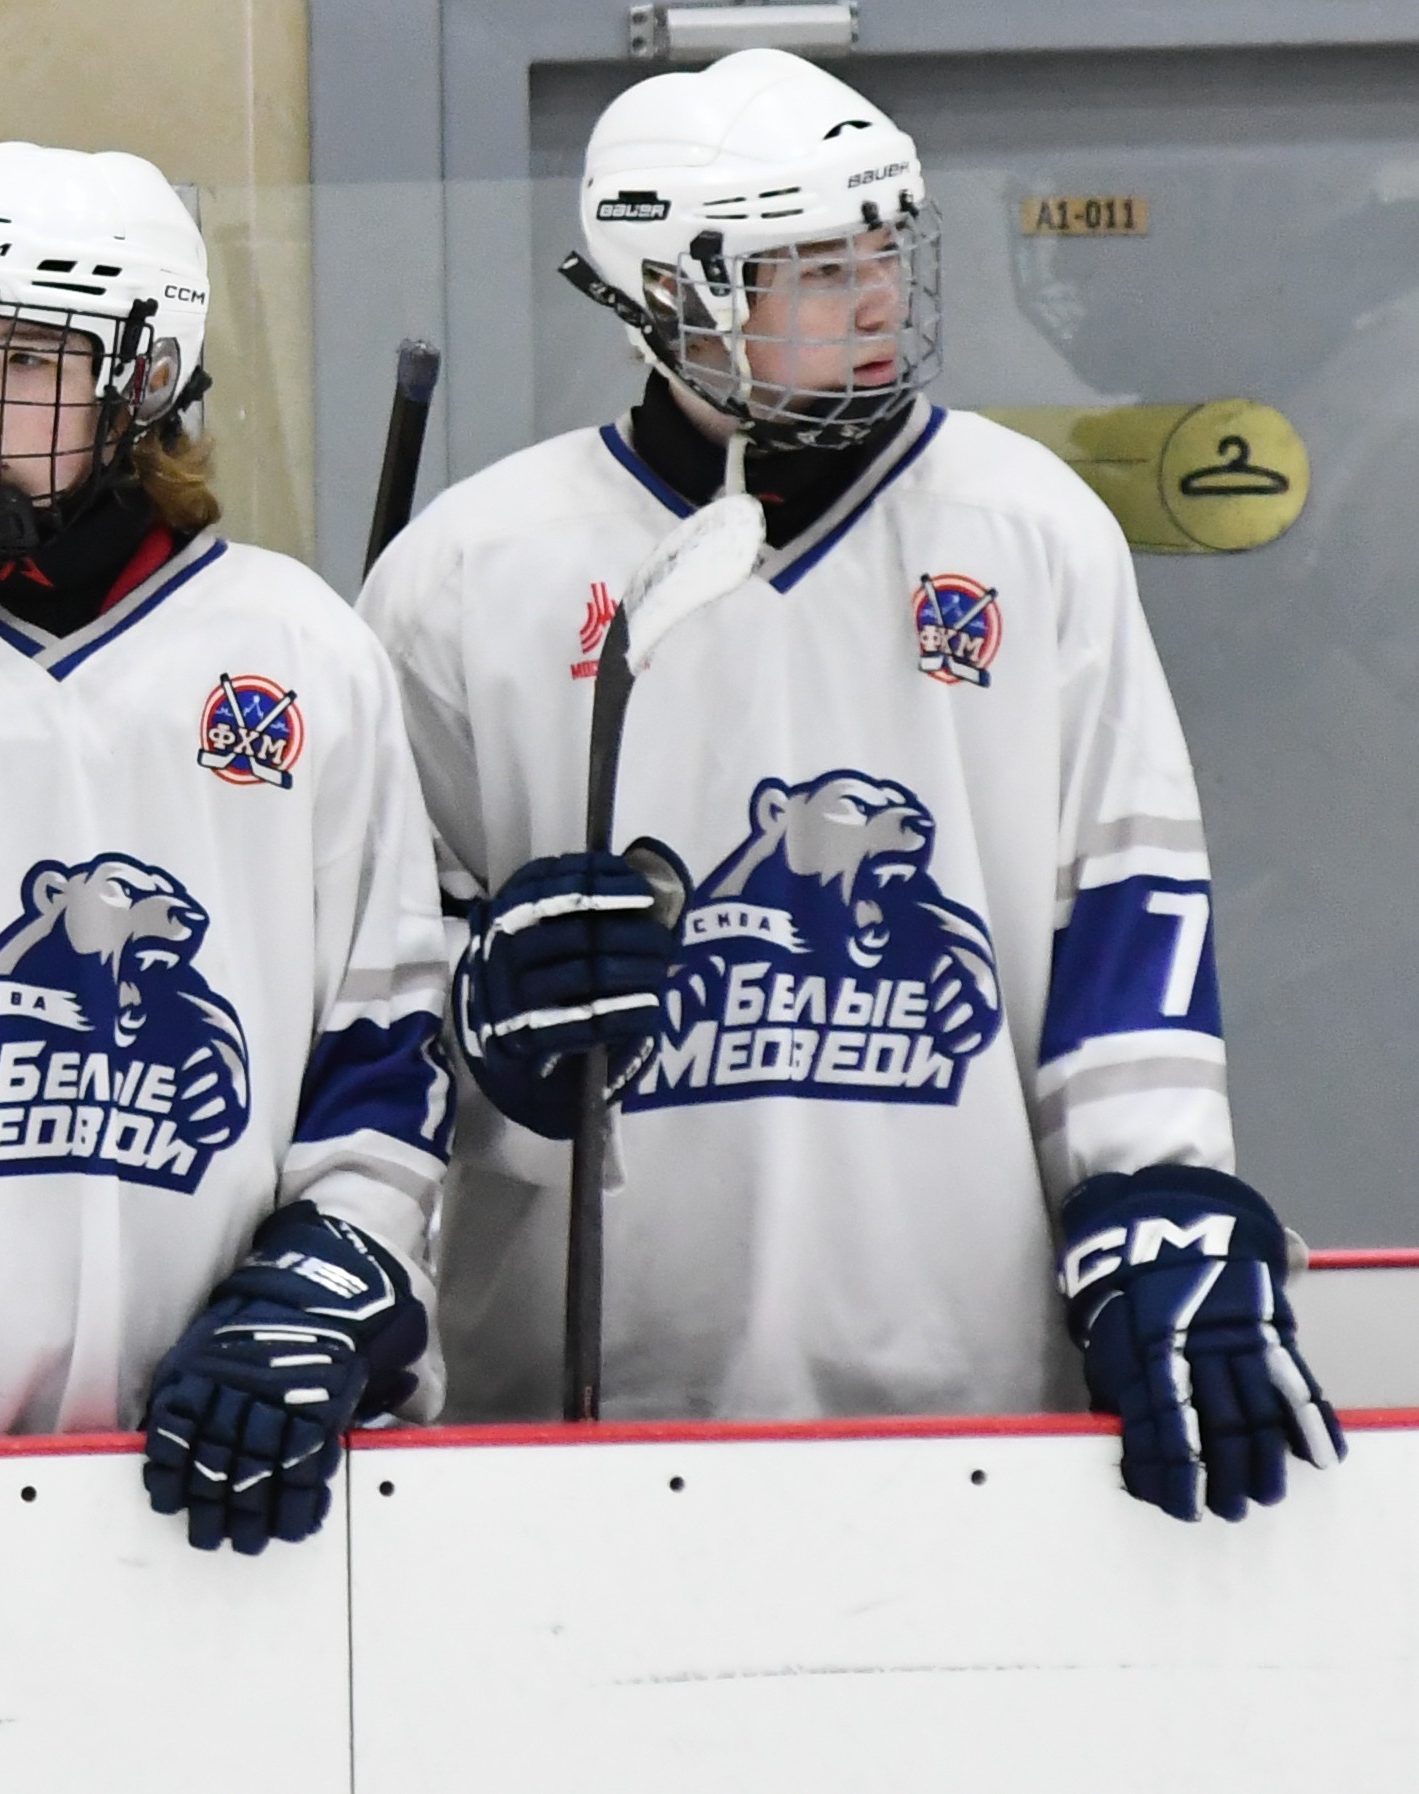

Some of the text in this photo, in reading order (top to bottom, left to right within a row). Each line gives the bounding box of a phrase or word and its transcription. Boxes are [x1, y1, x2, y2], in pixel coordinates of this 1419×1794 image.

[1036, 199, 1136, 231] A1-011
[164, 284, 206, 306] CCM
[208, 722, 287, 765] ФХМ
[692, 911, 773, 934] СКВА
[1145, 889, 1210, 1018] 7
[723, 961, 930, 1030] БЕЛЫЕ
[1059, 1214, 1237, 1299] CM
